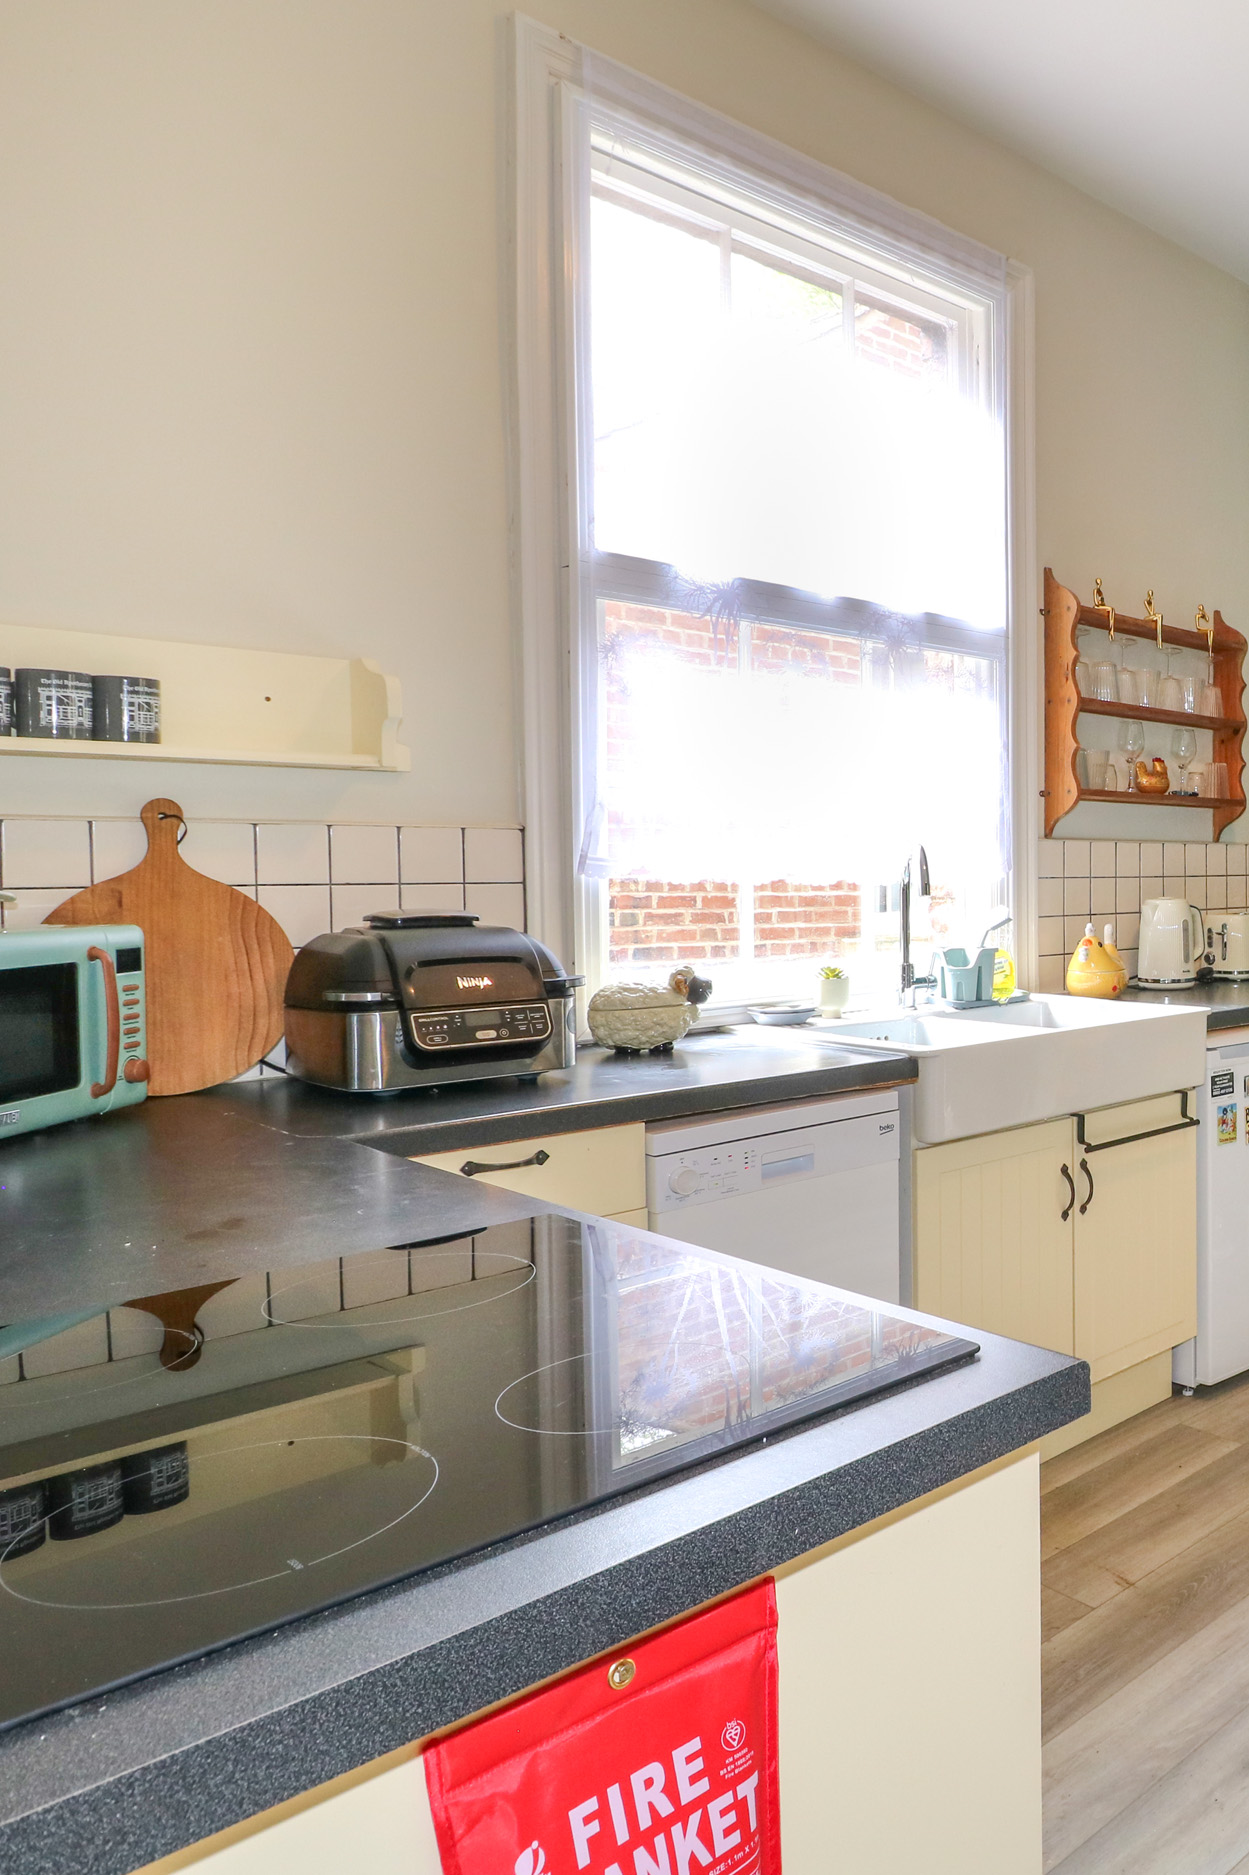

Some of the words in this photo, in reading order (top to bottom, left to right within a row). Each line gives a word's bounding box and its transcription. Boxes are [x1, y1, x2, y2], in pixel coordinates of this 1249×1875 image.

[456, 976, 493, 990] NINJA
[879, 1123, 895, 1132] beko
[726, 1717, 738, 1730] bsi
[568, 1736, 710, 1870] FIRE
[604, 1770, 760, 1875] NKET
